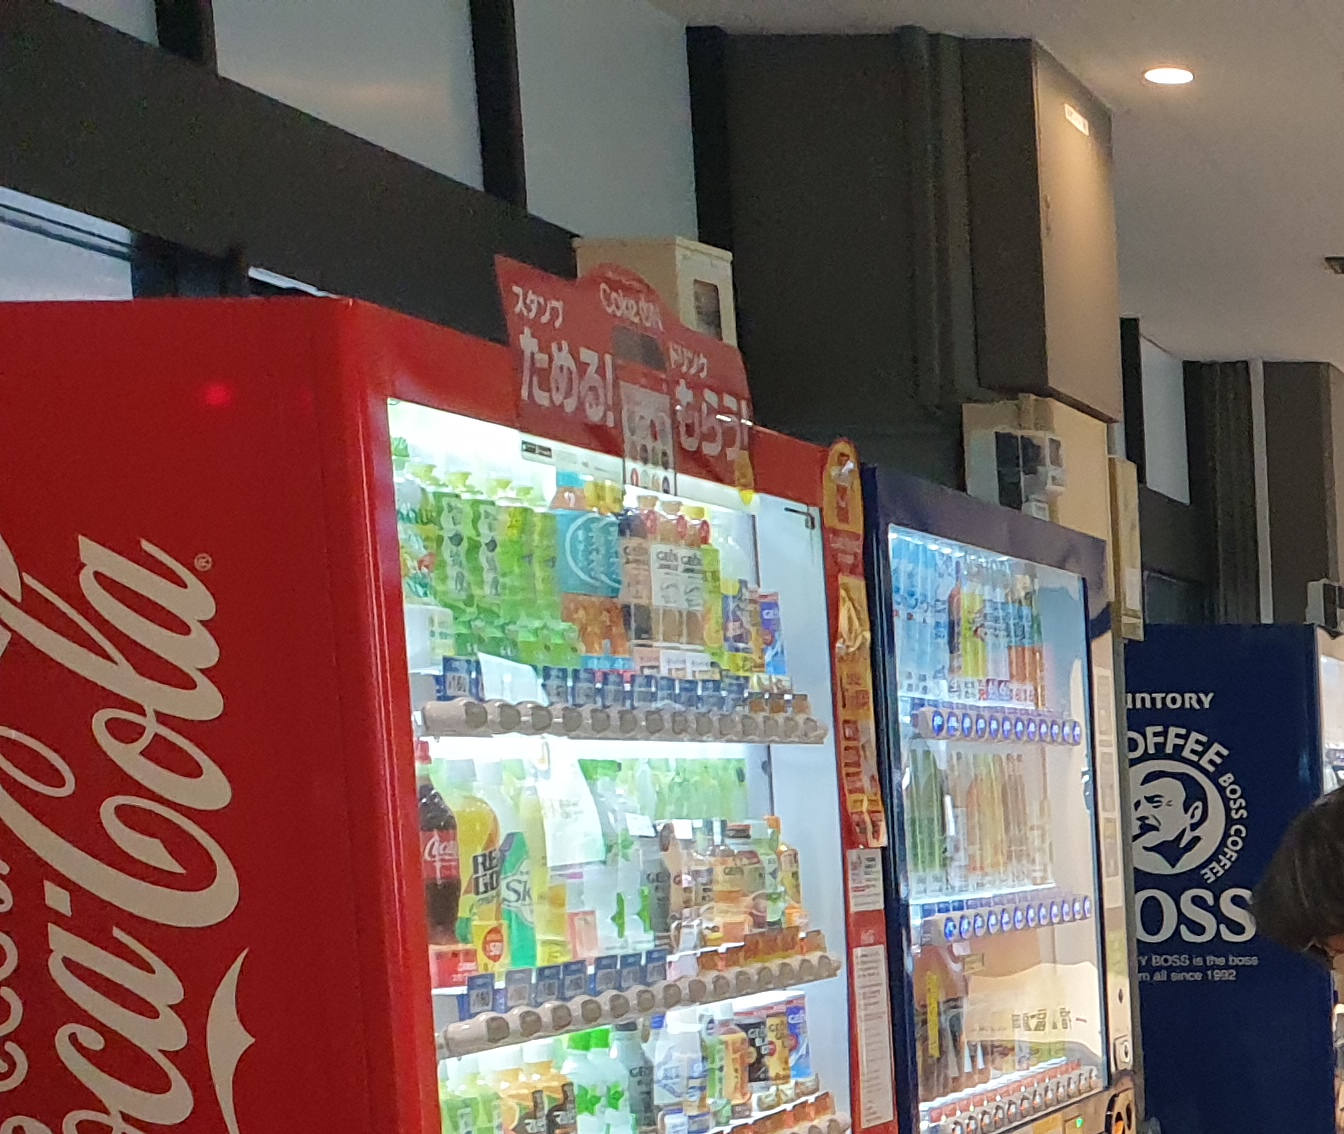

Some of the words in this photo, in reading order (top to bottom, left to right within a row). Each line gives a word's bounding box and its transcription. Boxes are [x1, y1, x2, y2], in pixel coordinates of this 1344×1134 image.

[512, 286, 564, 329] スタンプ
[600, 283, 642, 324] Coke
[1126, 692, 1215, 709] NTORY
[1127, 725, 1229, 773] OFFEE
[1218, 772, 1248, 820] BOSS
[1200, 823, 1248, 884] COFFEE
[1135, 887, 1257, 944] OSS
[1151, 955, 1189, 967] BOSS
[1206, 954, 1226, 967] the
[1228, 954, 1259, 967] boss
[1171, 969, 1203, 982] since
[1206, 969, 1236, 982] 1992
